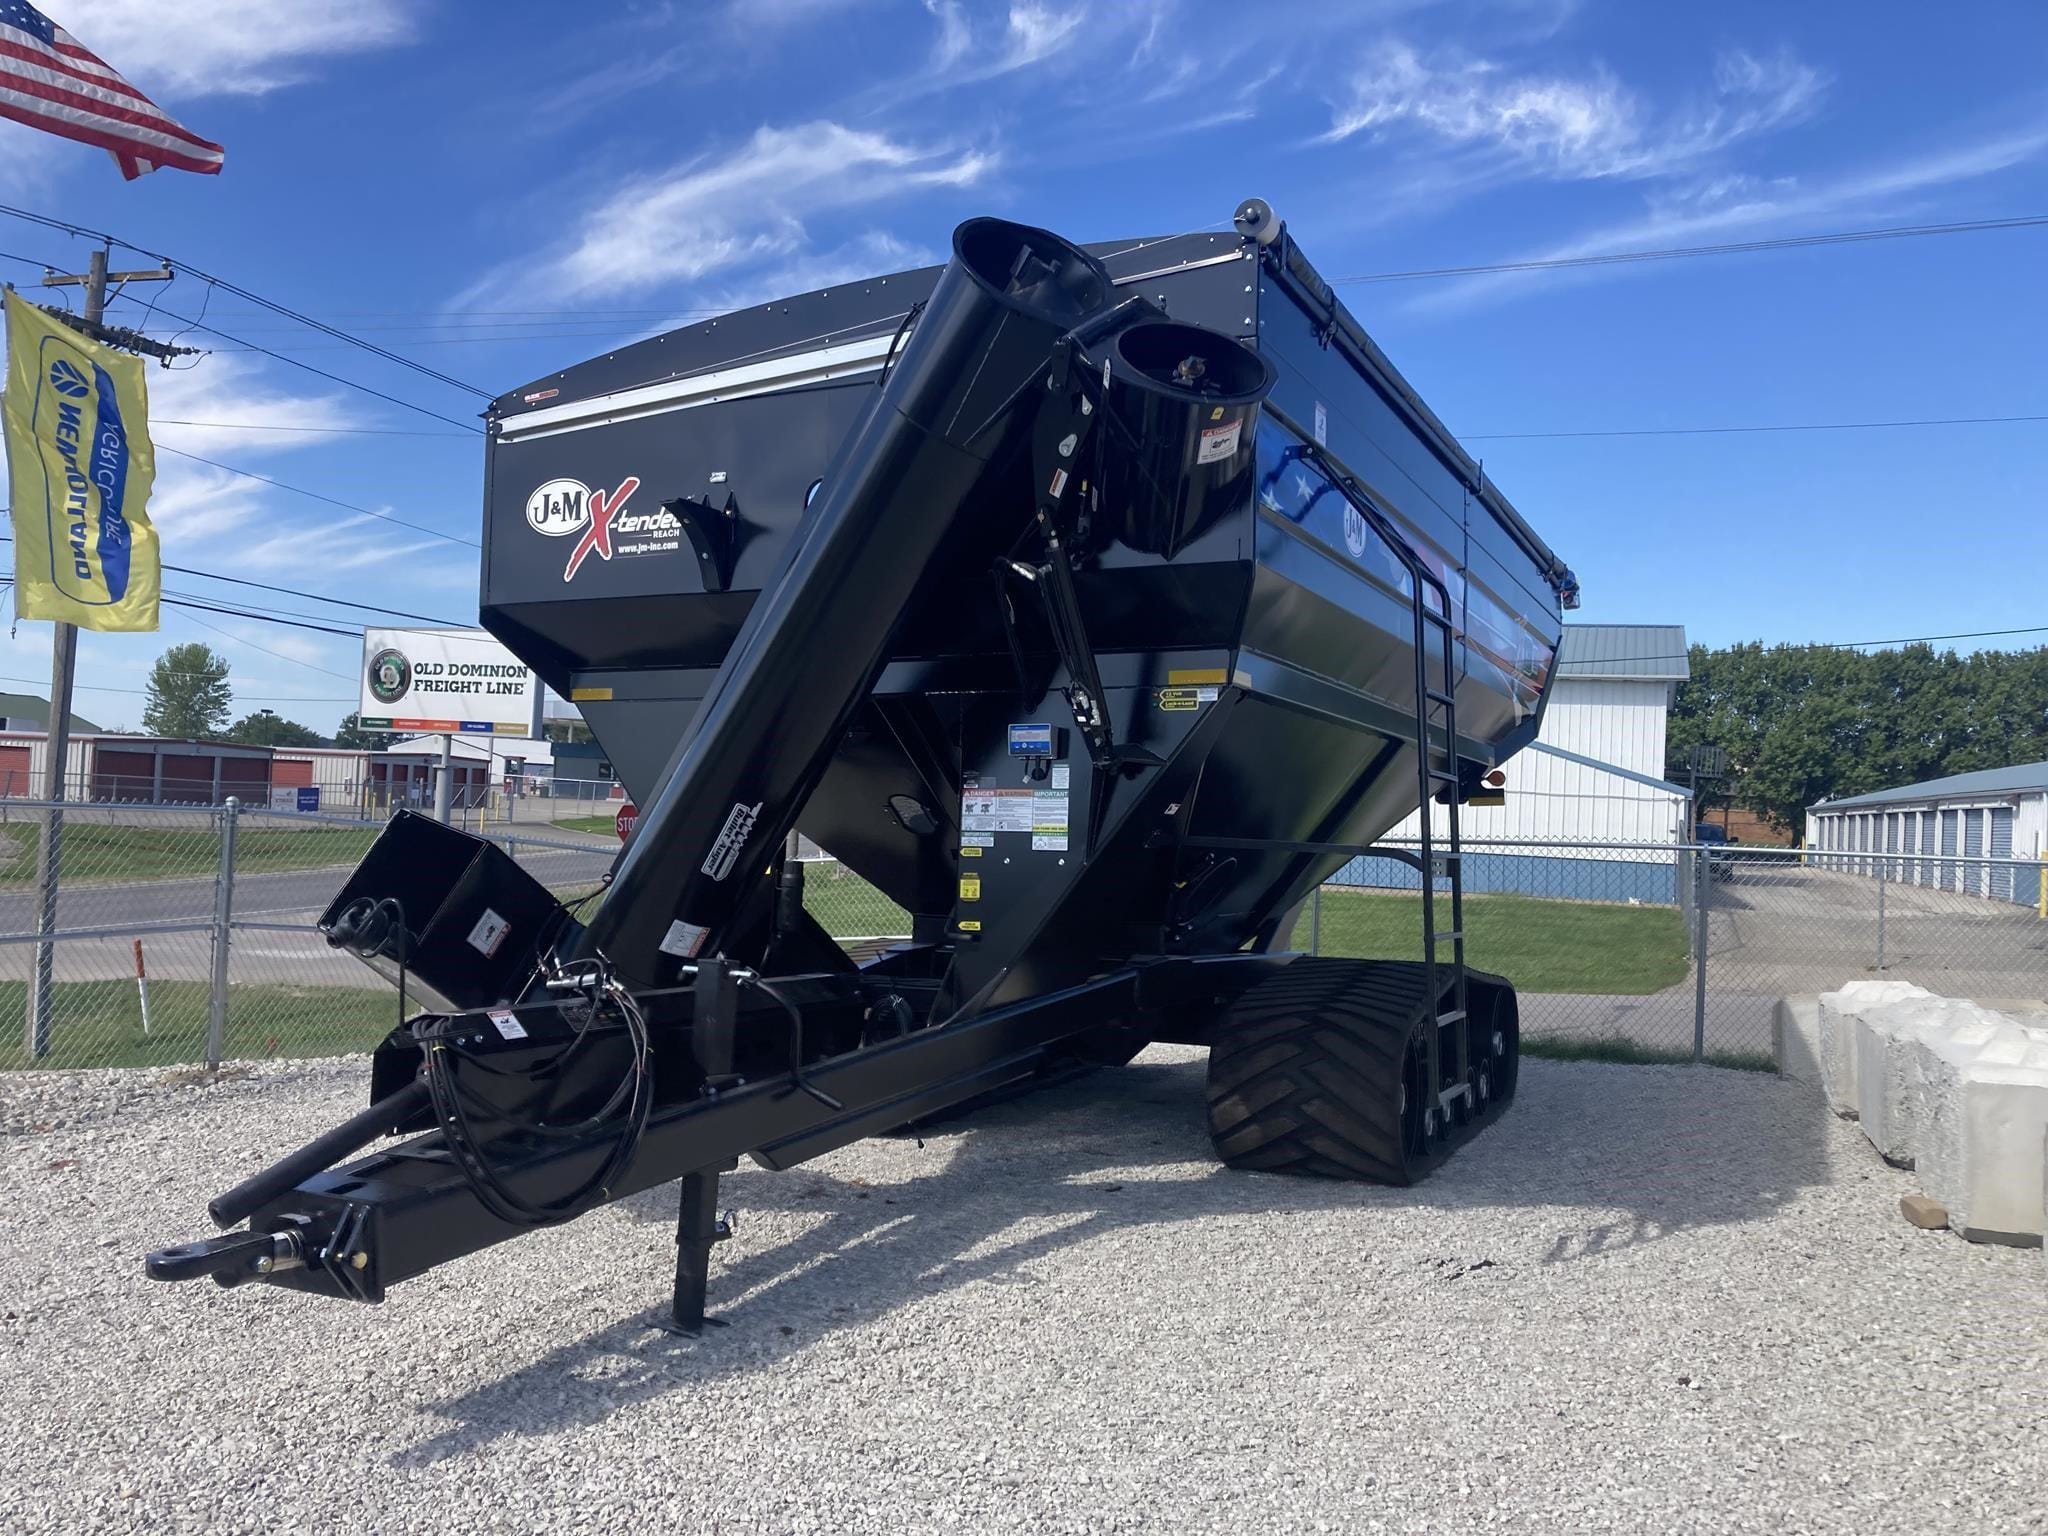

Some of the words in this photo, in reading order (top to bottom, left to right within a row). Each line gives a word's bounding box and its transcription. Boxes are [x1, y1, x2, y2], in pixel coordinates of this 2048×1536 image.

[533, 491, 583, 524] J&M
[652, 528, 680, 539] REACH
[1345, 508, 1363, 547] J&M
[617, 541, 679, 554] www.jm-inc.com
[413, 662, 444, 675] OLD
[449, 663, 529, 678] DOMINION
[413, 679, 482, 694] FREIGHT
[486, 682, 525, 695] LINE
[724, 808, 745, 839] Bullet
[707, 841, 727, 871] Auger
